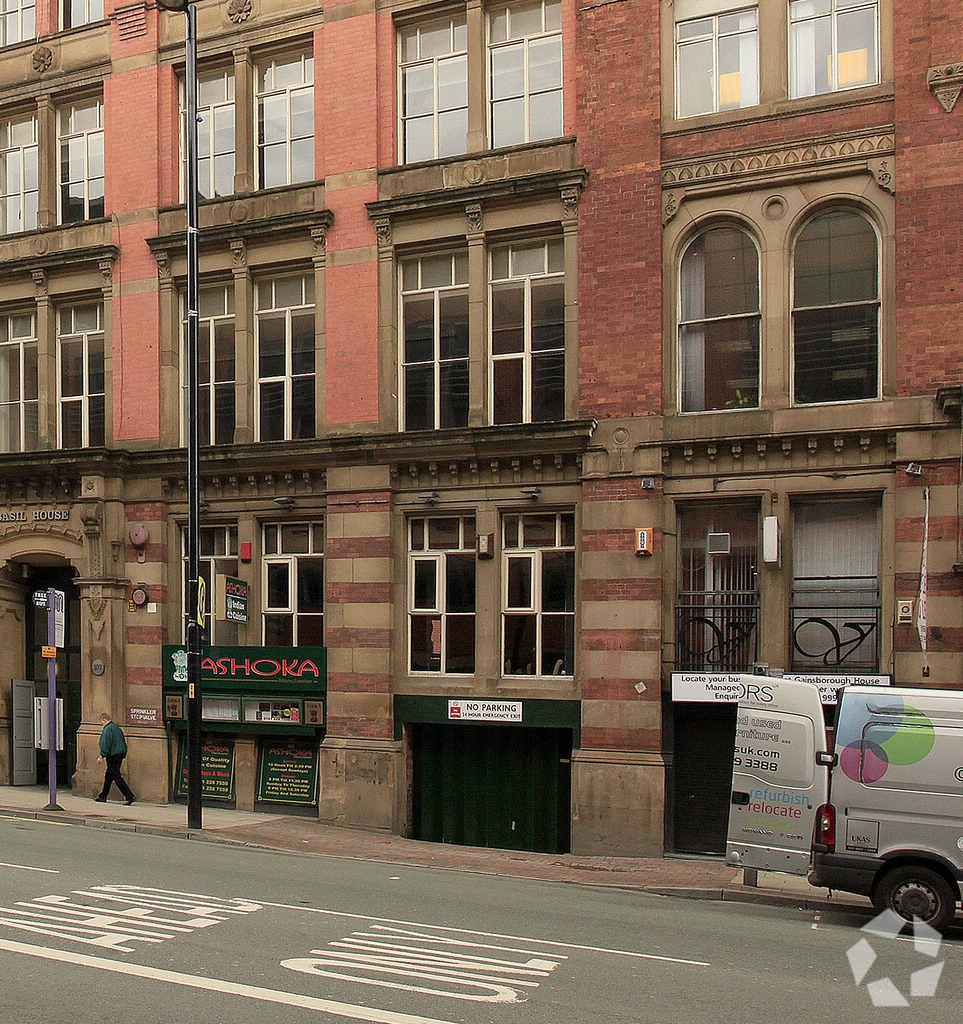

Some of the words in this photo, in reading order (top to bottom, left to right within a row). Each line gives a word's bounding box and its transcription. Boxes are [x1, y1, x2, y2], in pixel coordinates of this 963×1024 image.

[32, 510, 69, 521] HOUSE
[201, 657, 319, 678] ASHOKA
[794, 676, 851, 686] Gainsborough
[466, 703, 479, 711] NO
[482, 704, 517, 712] PARKING
[751, 718, 782, 730] used
[269, 748, 312, 756] ASHOKA
[210, 756, 230, 764] Quality
[745, 758, 778, 772] 3388
[749, 788, 810, 805] refurbish
[748, 802, 802, 818] relocate
[851, 835, 871, 843] UKAS
